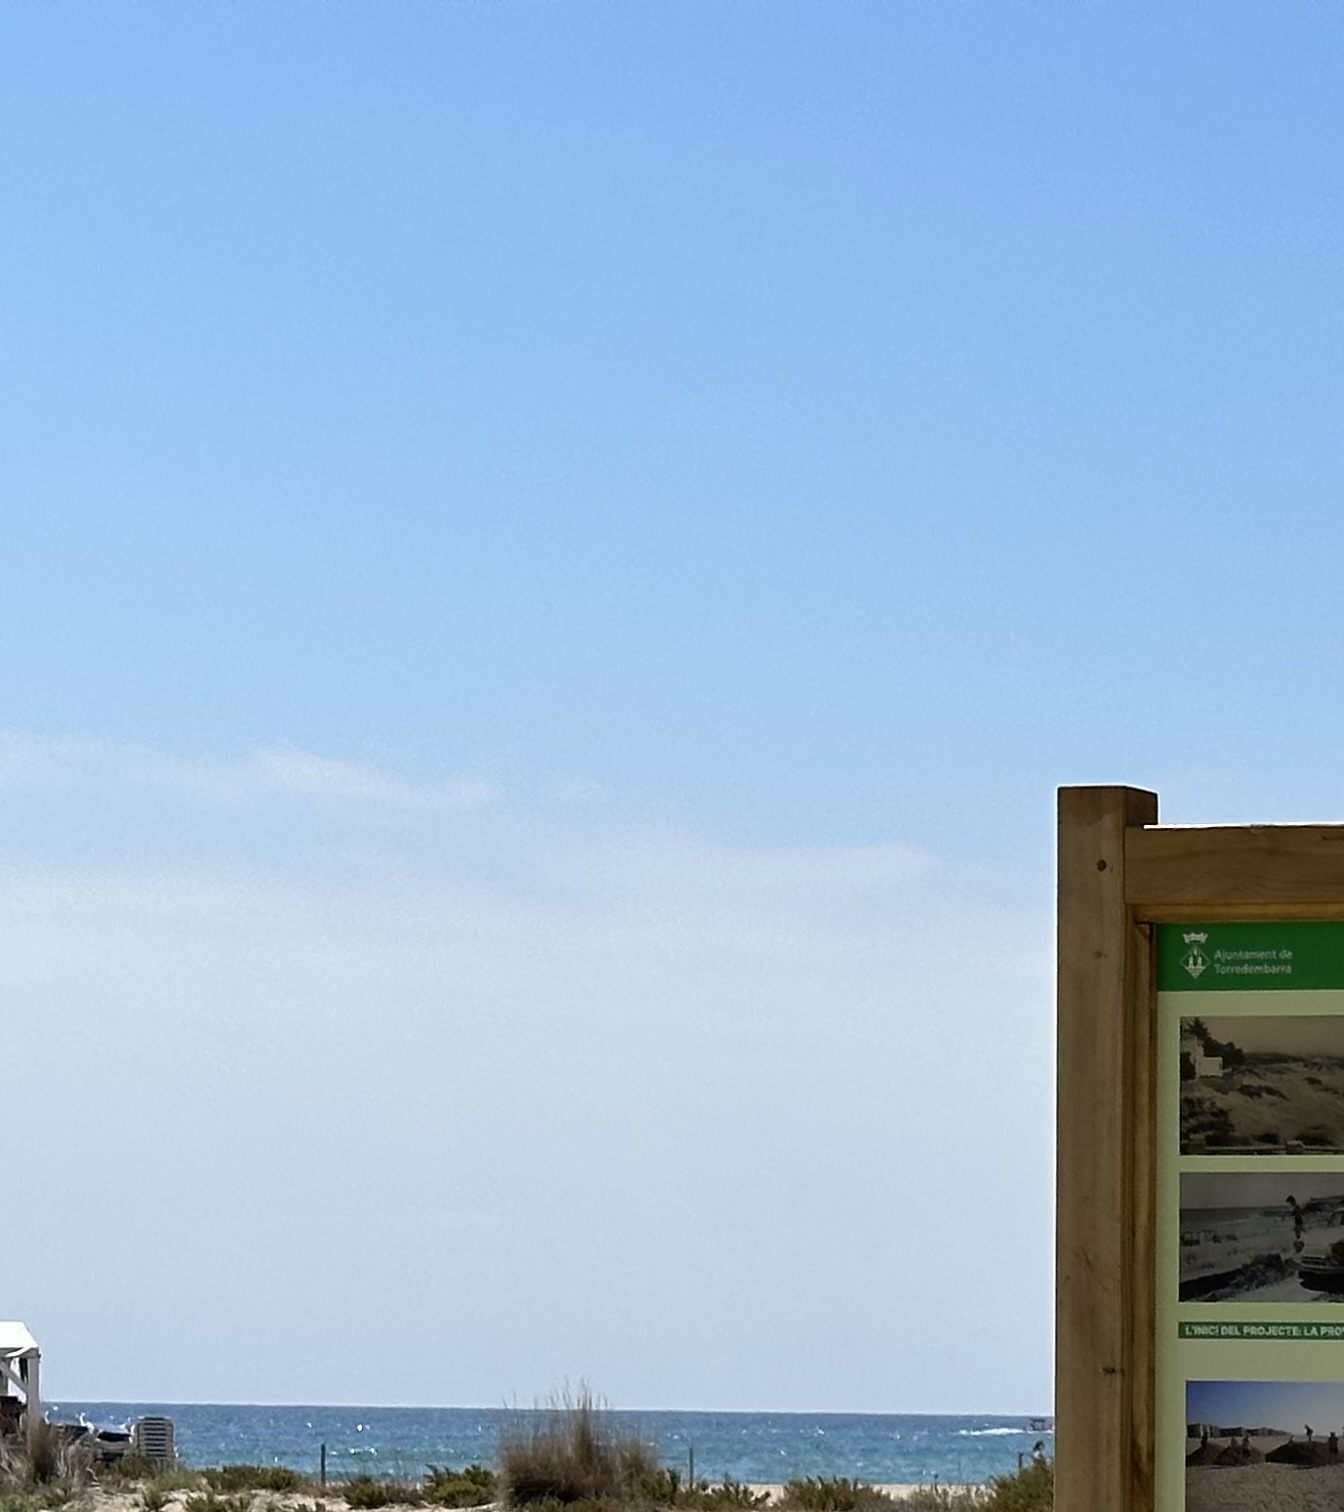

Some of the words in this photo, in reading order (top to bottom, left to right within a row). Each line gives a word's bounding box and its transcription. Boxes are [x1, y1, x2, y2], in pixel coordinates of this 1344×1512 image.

[1214, 949, 1277, 963] Ajuntament
[1279, 949, 1293, 959] de
[1213, 964, 1291, 974] Torredembarra
[1185, 1326, 1219, 1335] L'INICI
[1221, 1326, 1241, 1335] DEL
[1243, 1326, 1301, 1336] PROJECTE:
[1304, 1327, 1318, 1336] LA
